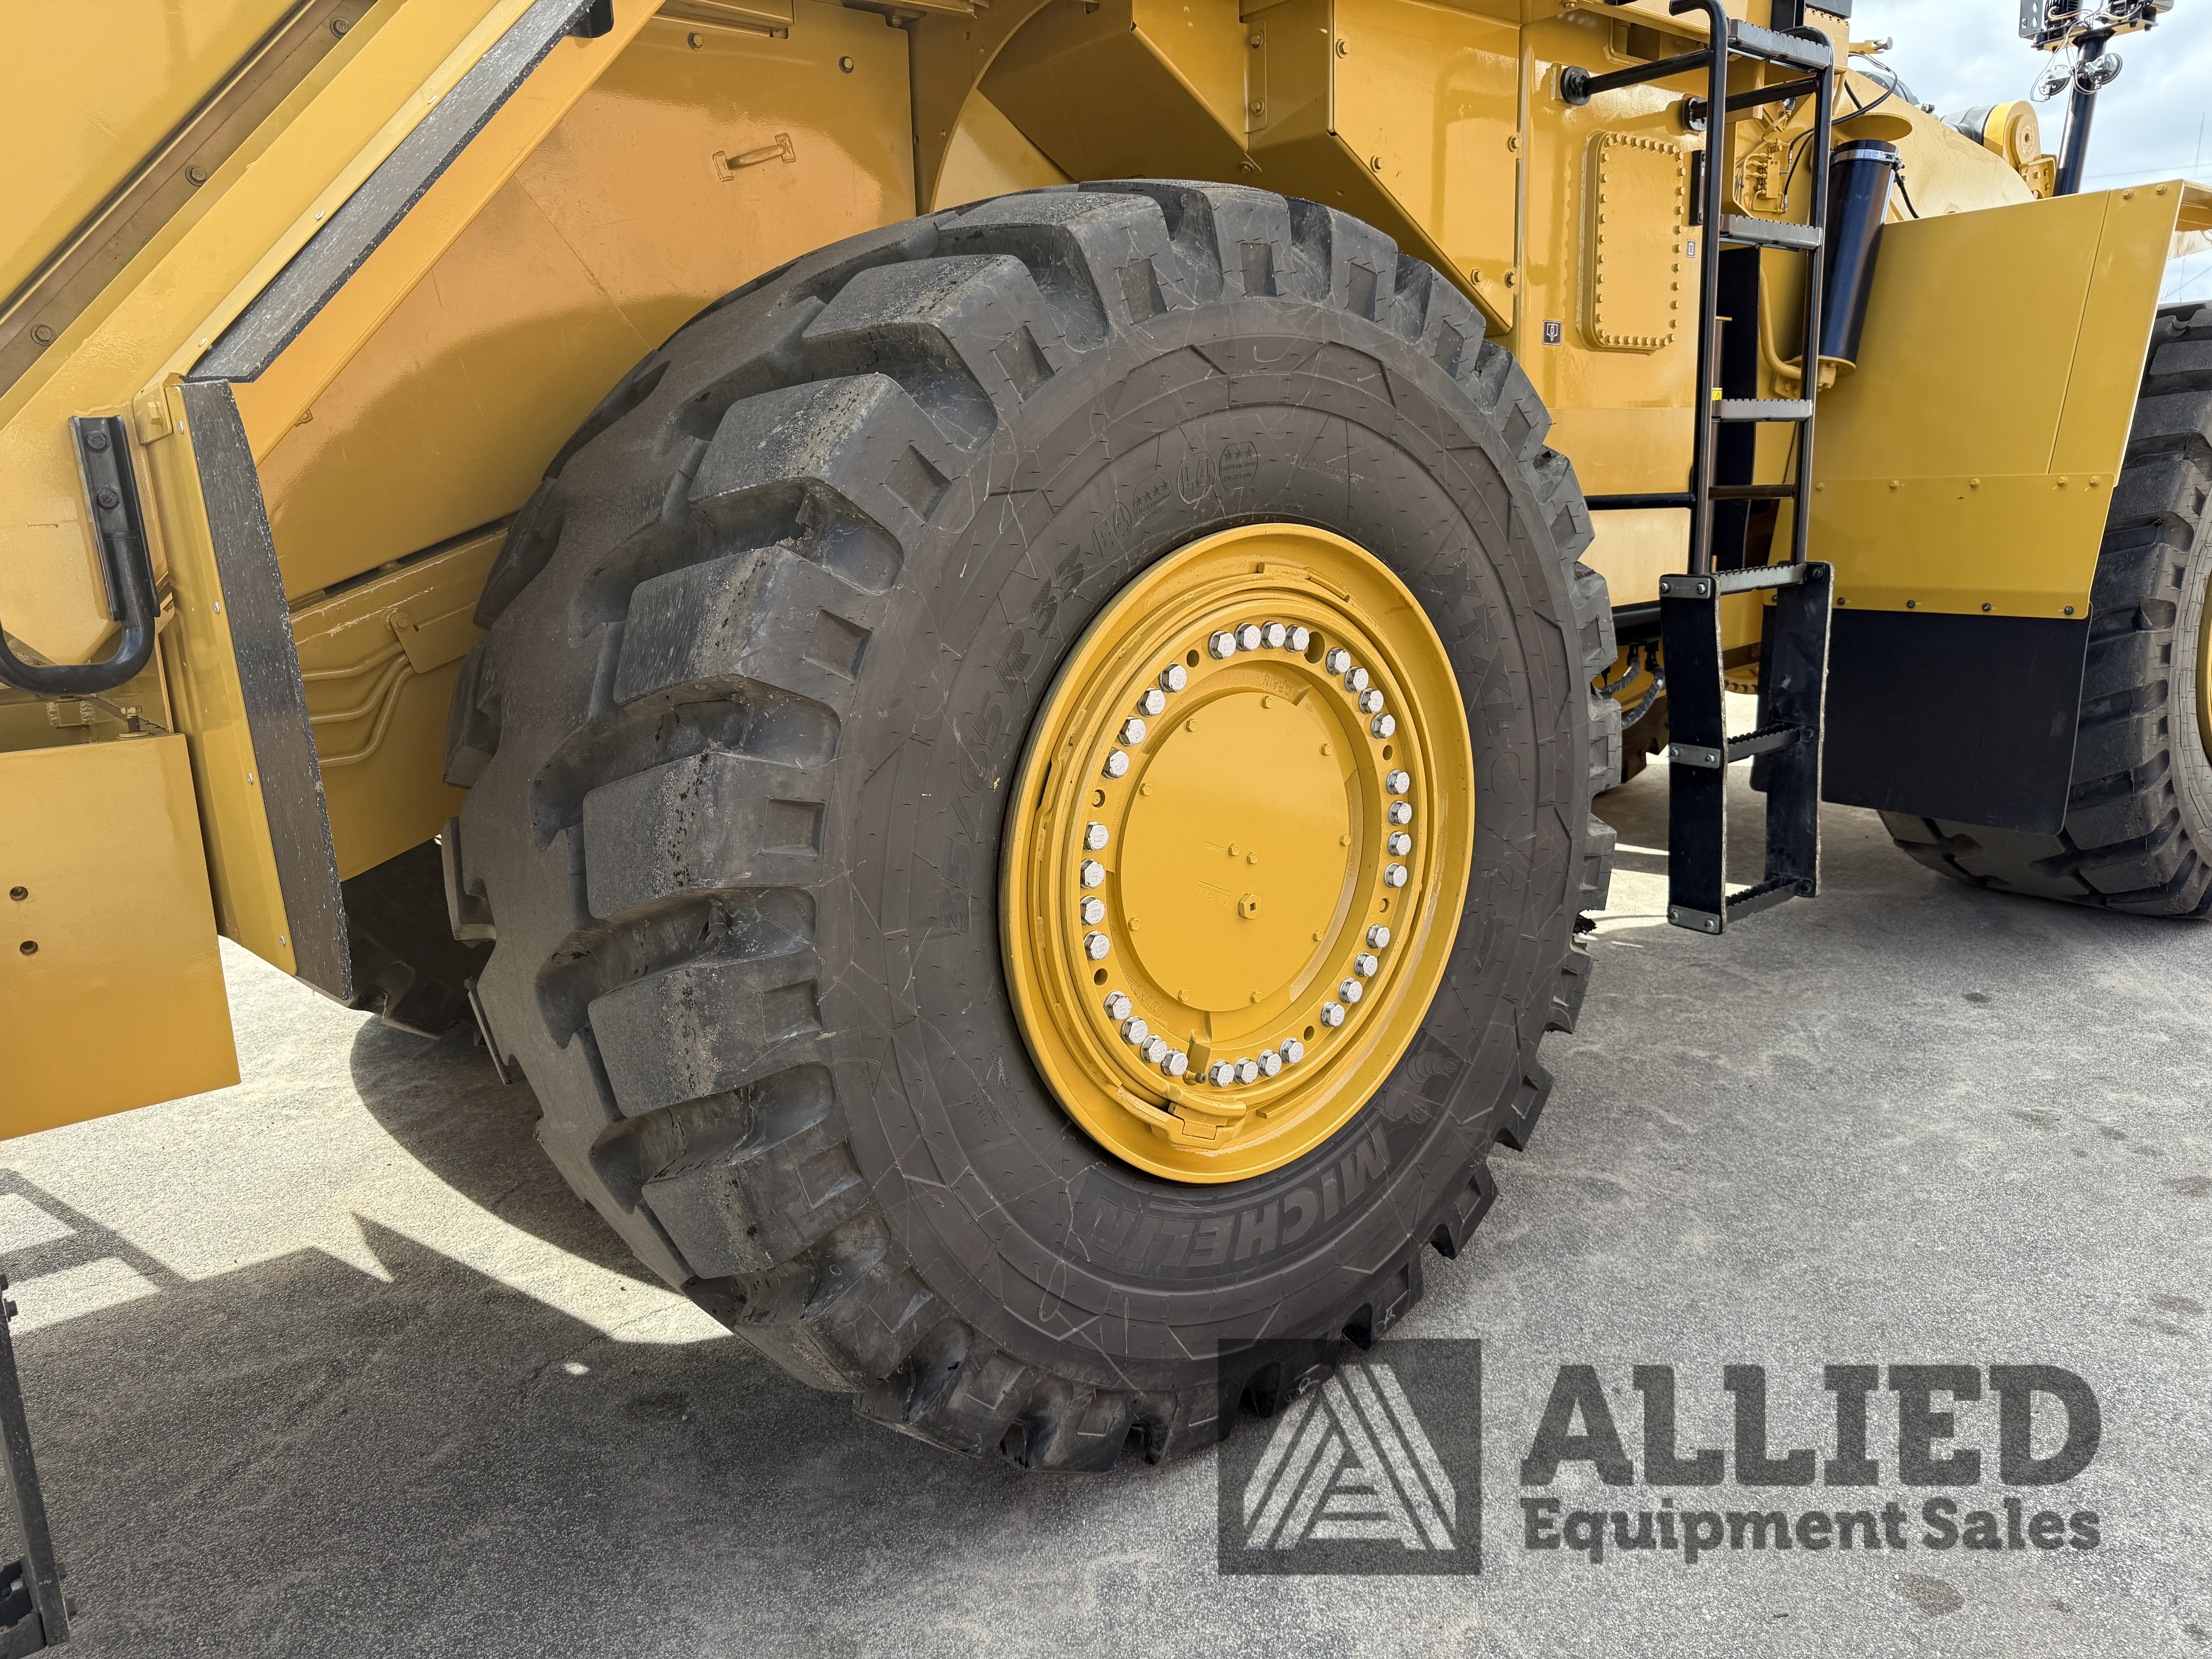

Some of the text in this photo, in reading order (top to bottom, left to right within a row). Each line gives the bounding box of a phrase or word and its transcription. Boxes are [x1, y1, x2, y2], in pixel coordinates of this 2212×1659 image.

[1197, 886, 1229, 905] OIL FILL
[1077, 1121, 1391, 1267] MICHELIN
